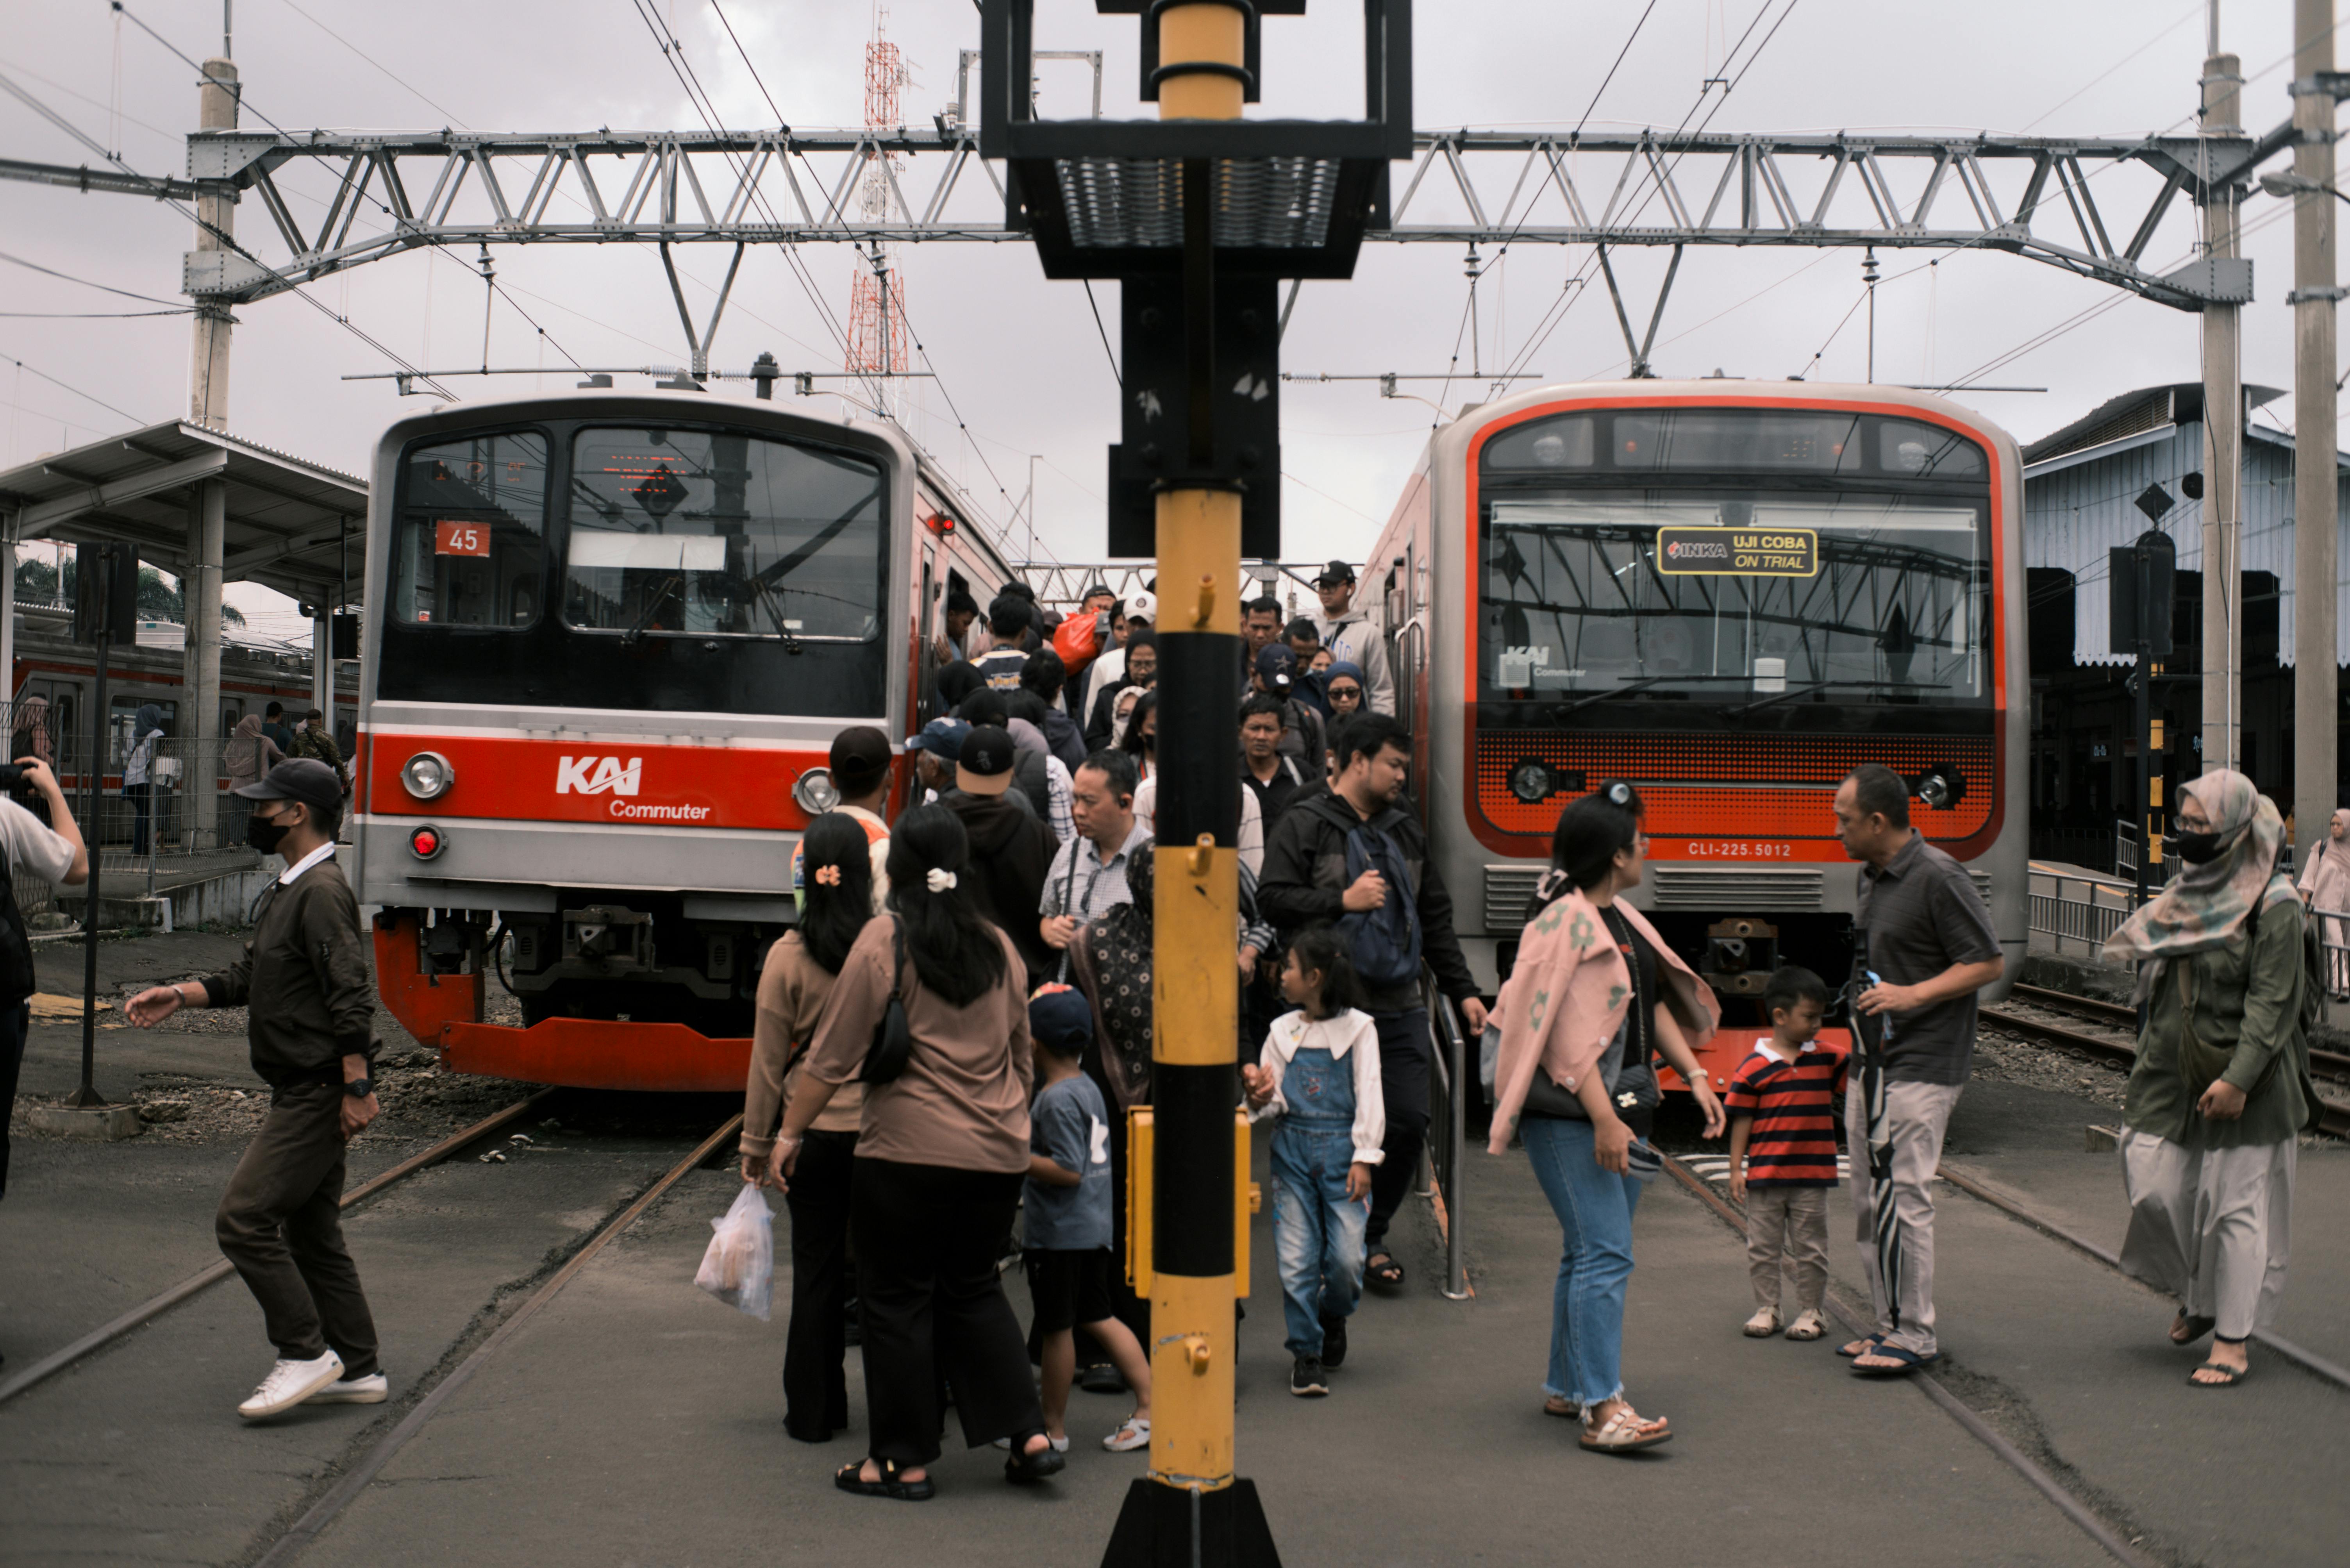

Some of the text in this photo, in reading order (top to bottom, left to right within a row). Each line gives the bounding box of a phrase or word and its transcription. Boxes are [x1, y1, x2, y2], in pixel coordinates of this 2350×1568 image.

[449, 529, 477, 550] 45
[1733, 536, 1807, 549] UJI COBA
[1680, 543, 1728, 558] INKA
[1735, 555, 1805, 569] ON TRIAL
[1534, 666, 1586, 677] Commuter
[556, 756, 642, 796] KAI
[609, 800, 710, 819] Commuter
[1688, 842, 1791, 857] CLI-225.5012
